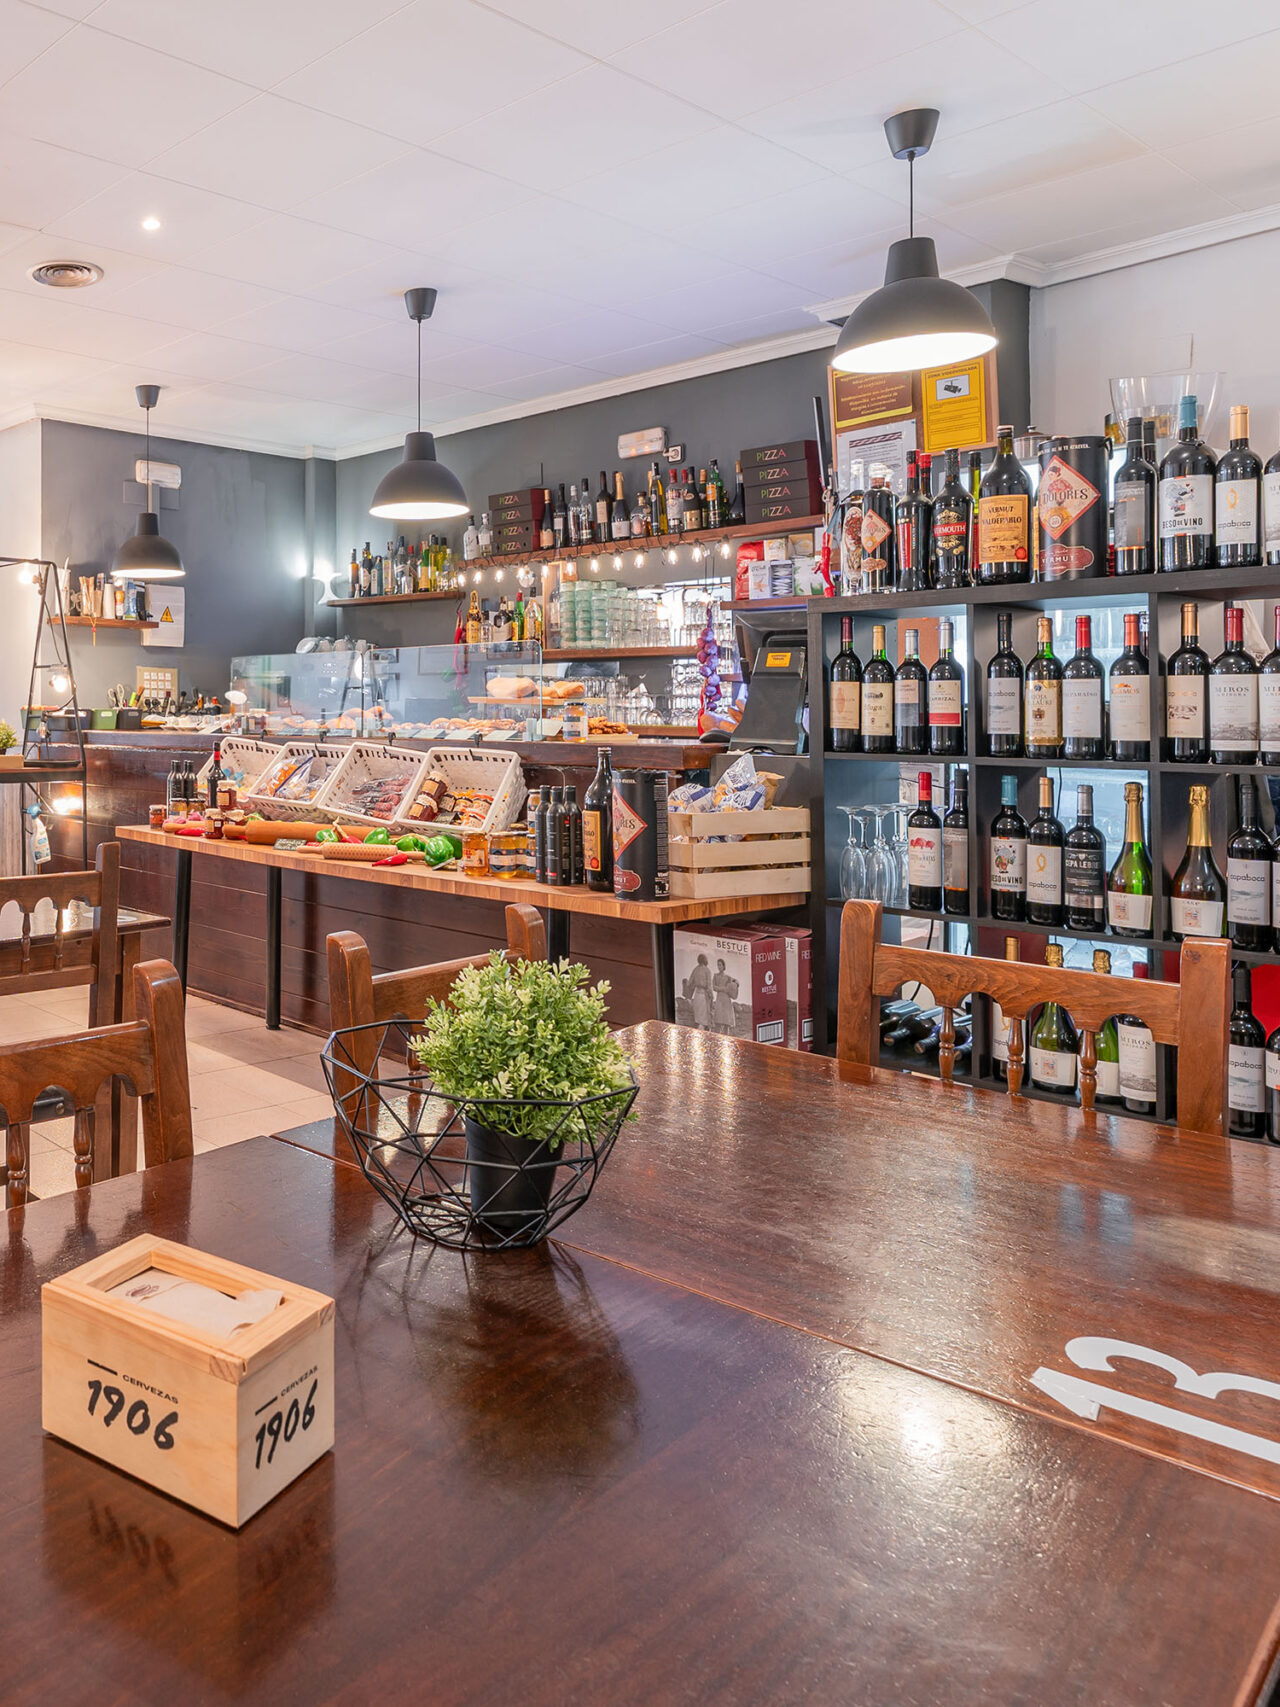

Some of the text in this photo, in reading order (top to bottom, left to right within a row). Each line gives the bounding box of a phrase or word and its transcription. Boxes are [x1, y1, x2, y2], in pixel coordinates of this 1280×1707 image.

[756, 449, 787, 462] PIZZA
[759, 468, 789, 480] PIZZA
[761, 486, 791, 499] PIZZA
[1041, 488, 1089, 504] DOLORES
[499, 496, 519, 505] PIZZA
[502, 510, 520, 519] PIZZA
[762, 505, 792, 518] PIZZA
[1183, 518, 1203, 527] VINO
[503, 526, 523, 536] PIZZA
[502, 541, 521, 551] PIZZA
[716, 940, 749, 953] BESTUÉ
[279, 1365, 319, 1398] CERVEZAS
[122, 1374, 179, 1404] CERVEZAS
[87, 1379, 180, 1450] 1906
[255, 1378, 318, 1469] 1906
